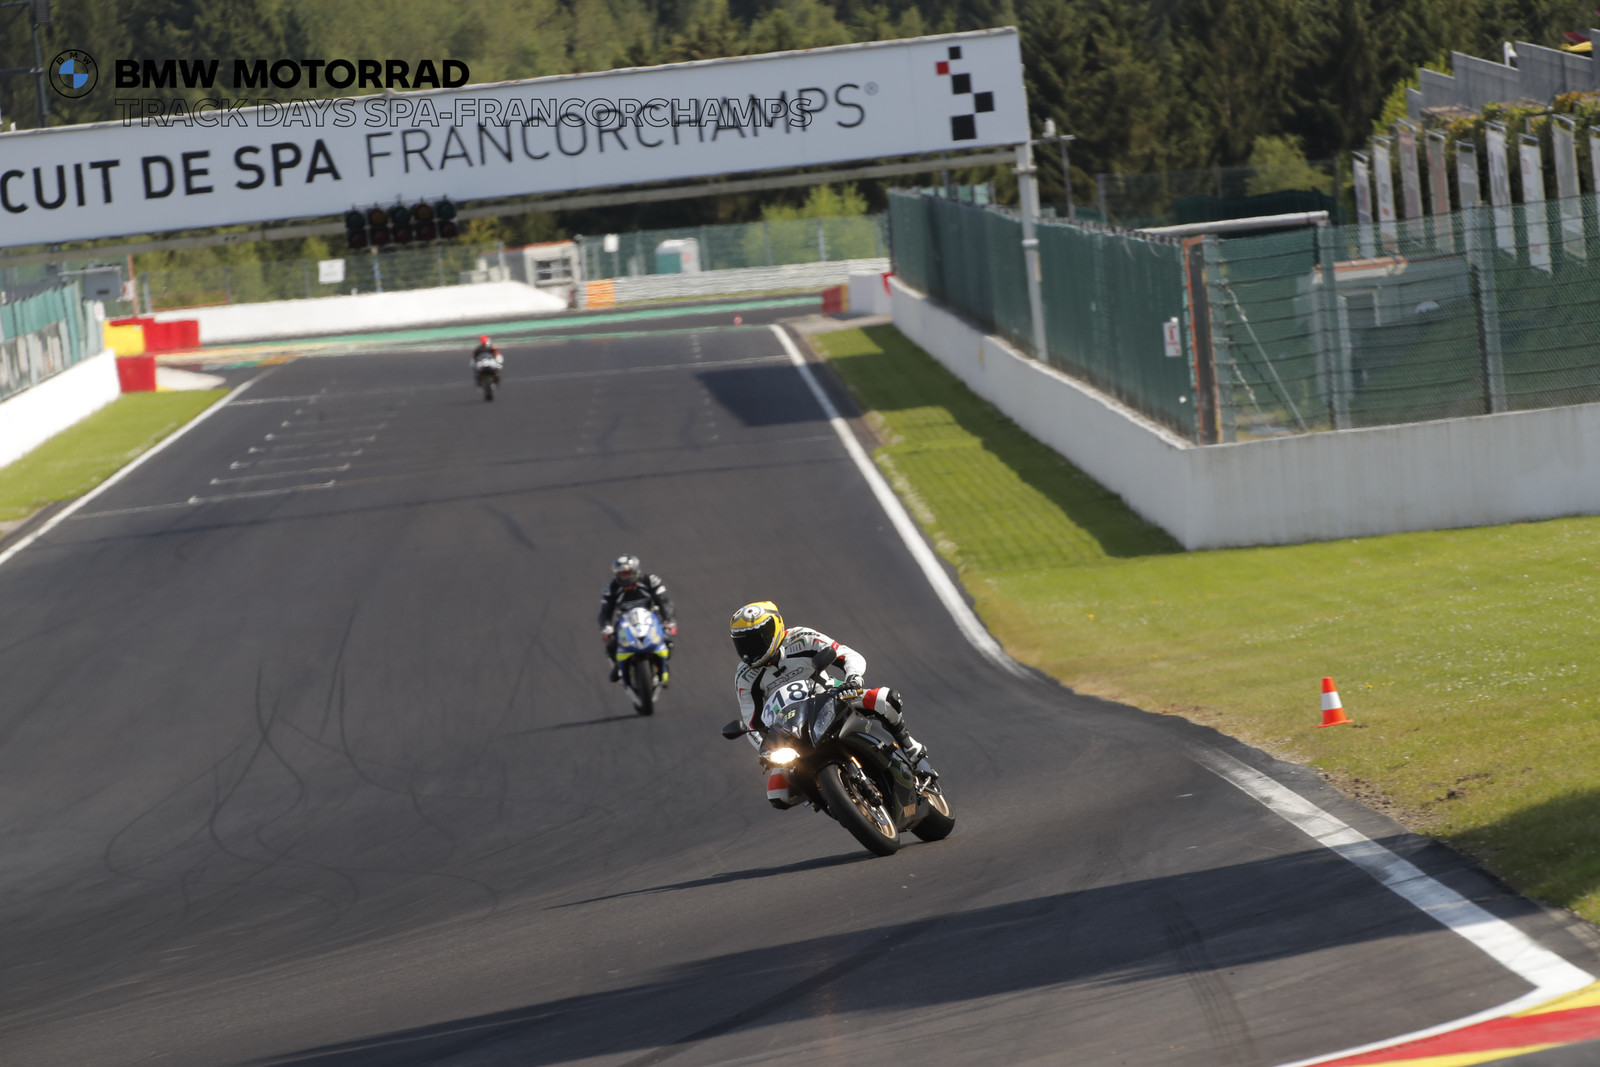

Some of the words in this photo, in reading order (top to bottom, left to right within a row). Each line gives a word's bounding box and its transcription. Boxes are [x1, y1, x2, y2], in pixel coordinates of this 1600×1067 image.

[0, 160, 119, 213] CUIT
[142, 150, 214, 199] DE
[234, 139, 341, 190] SPA
[762, 682, 808, 724] 318
